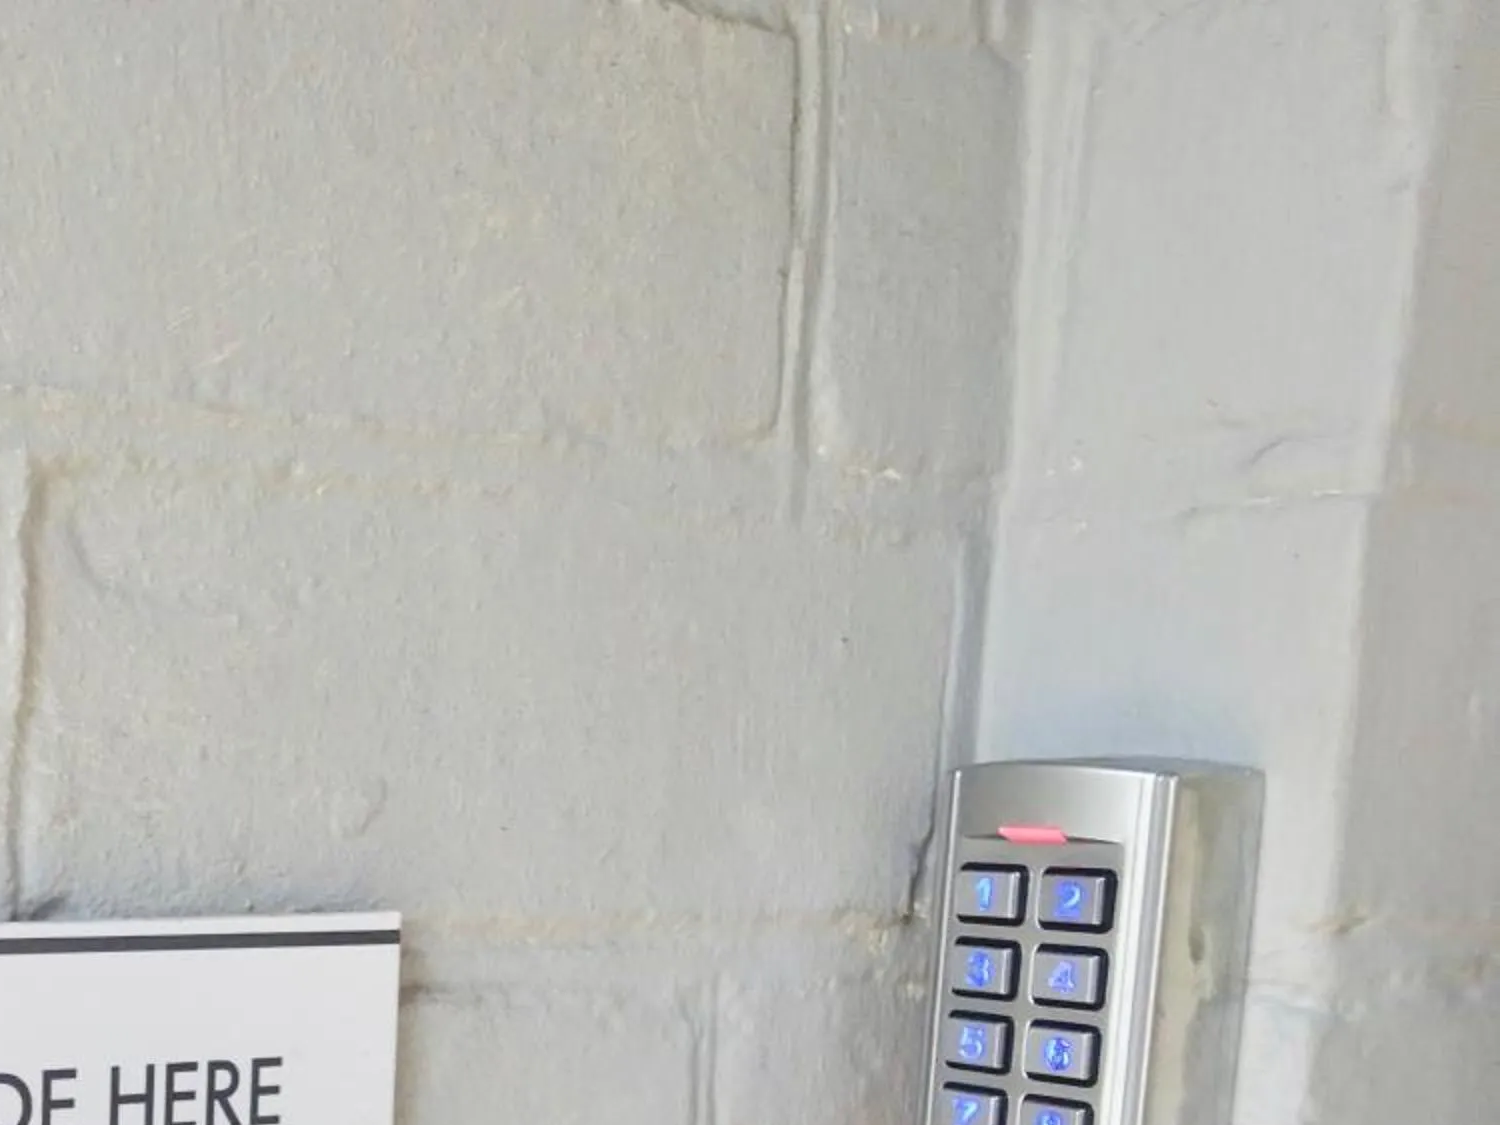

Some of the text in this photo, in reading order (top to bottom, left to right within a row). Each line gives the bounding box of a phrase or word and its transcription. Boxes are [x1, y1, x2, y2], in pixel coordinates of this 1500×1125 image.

[975, 877, 1088, 919] 1 2
[1048, 961, 1077, 993] 4
[960, 1025, 987, 1060] 5
